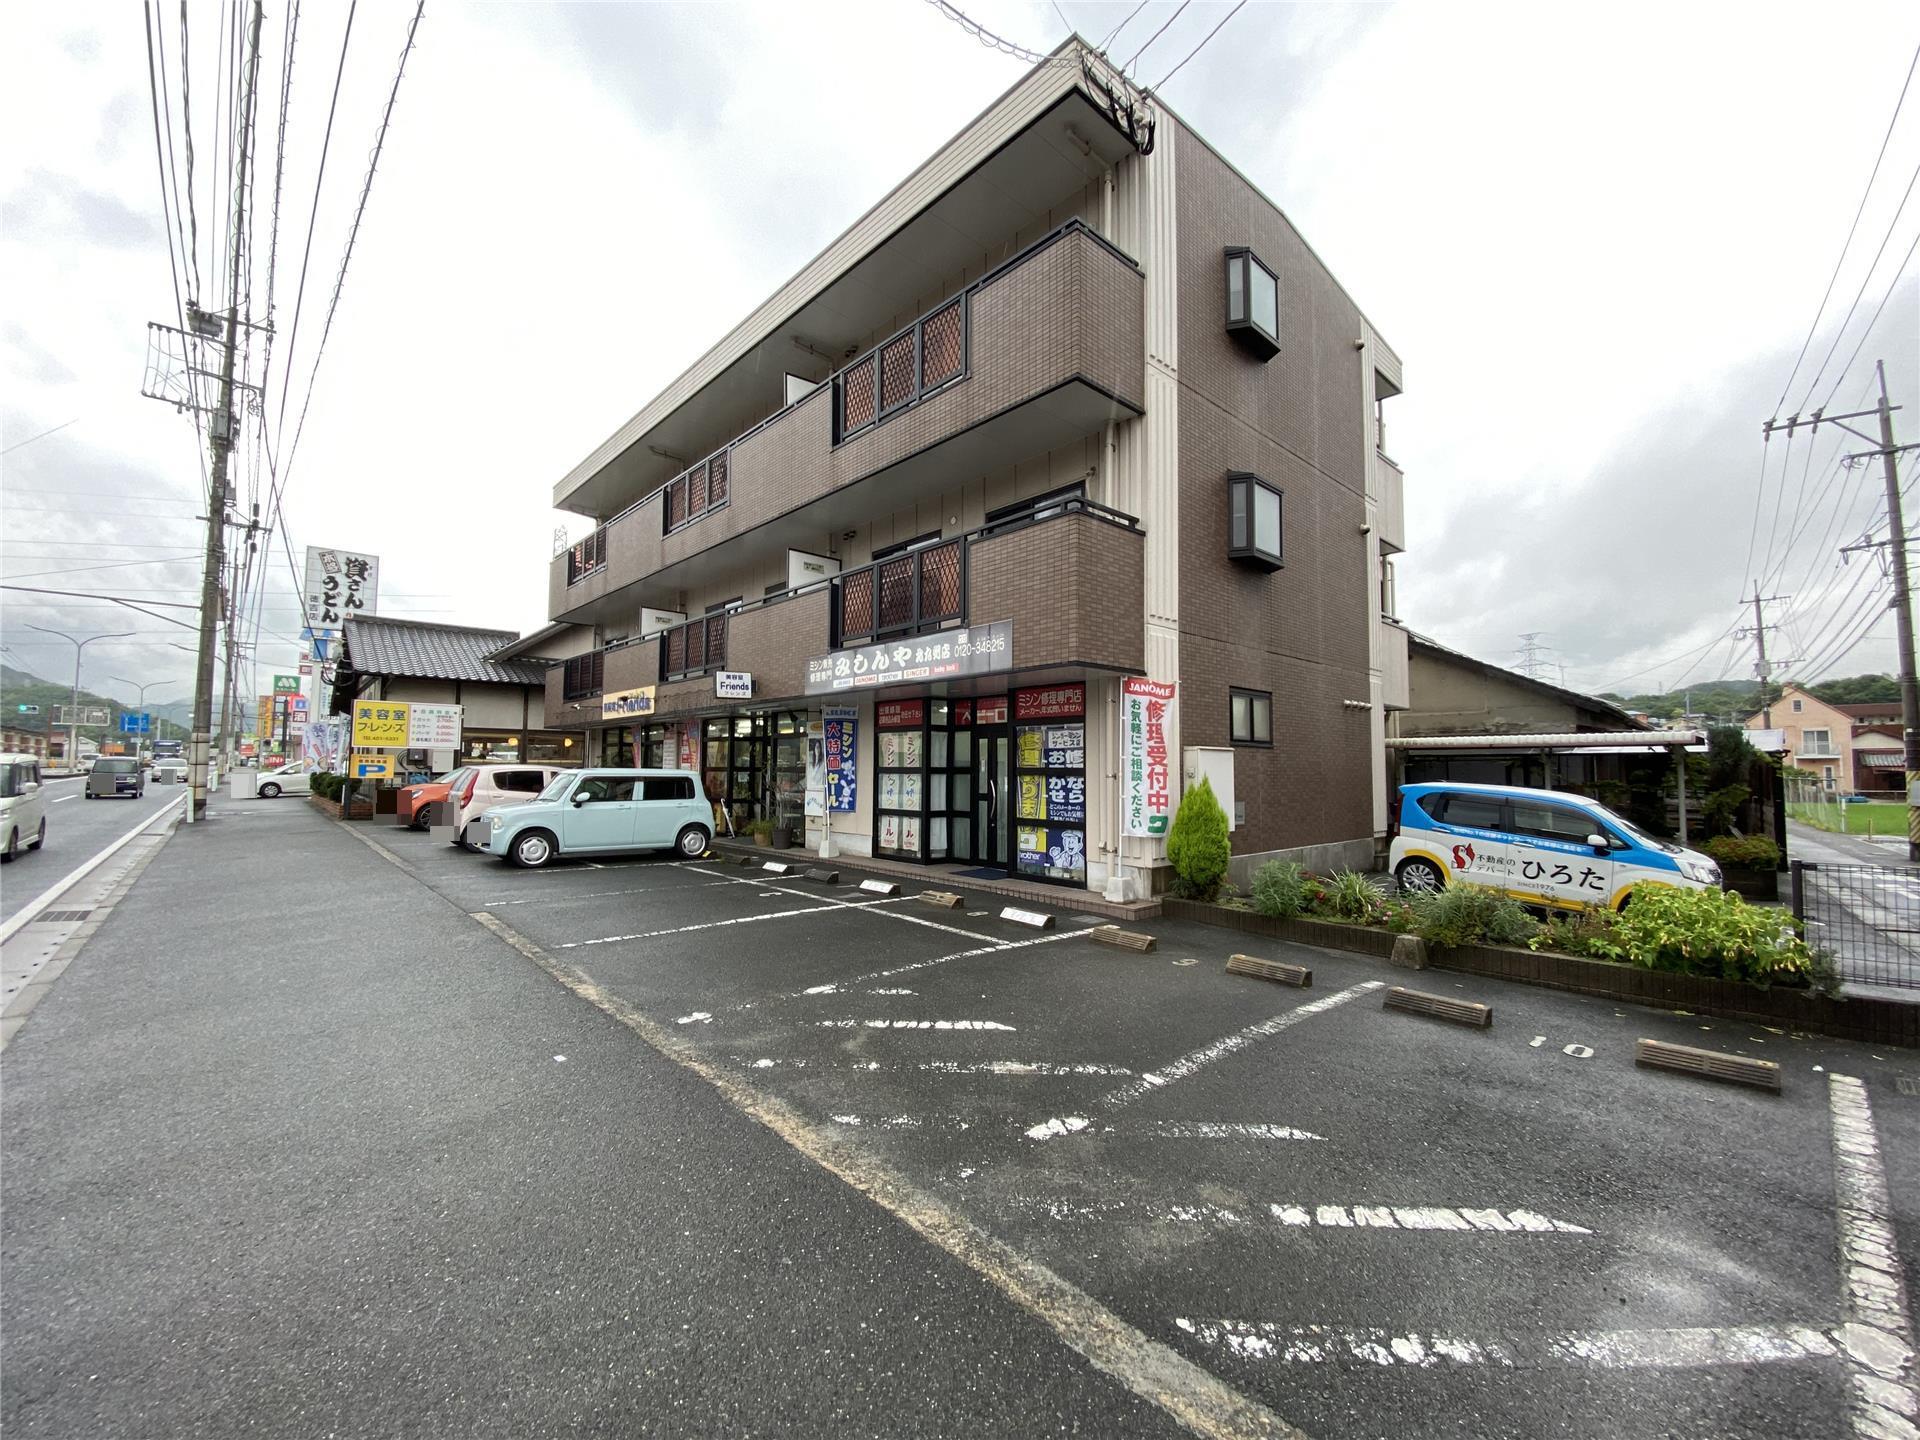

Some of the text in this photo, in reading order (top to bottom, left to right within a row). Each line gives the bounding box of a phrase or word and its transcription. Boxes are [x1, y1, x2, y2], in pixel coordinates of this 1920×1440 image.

[345, 557, 368, 609] 資さん
[321, 575, 340, 624] うどん
[720, 681, 750, 691] Friends
[1018, 689, 1082, 706] ミシン修理専門店
[1129, 682, 1172, 696] JANOME
[359, 708, 406, 720] 美容室
[828, 722, 841, 770] 大特価
[1146, 700, 1169, 814] 修理受付中
[1131, 698, 1142, 830] お気軽にご相談ください
[828, 773, 839, 807] セール
[1476, 863, 1515, 876] デパート
[1477, 853, 1516, 867] 不動産の
[1522, 860, 1605, 891] ひろた
